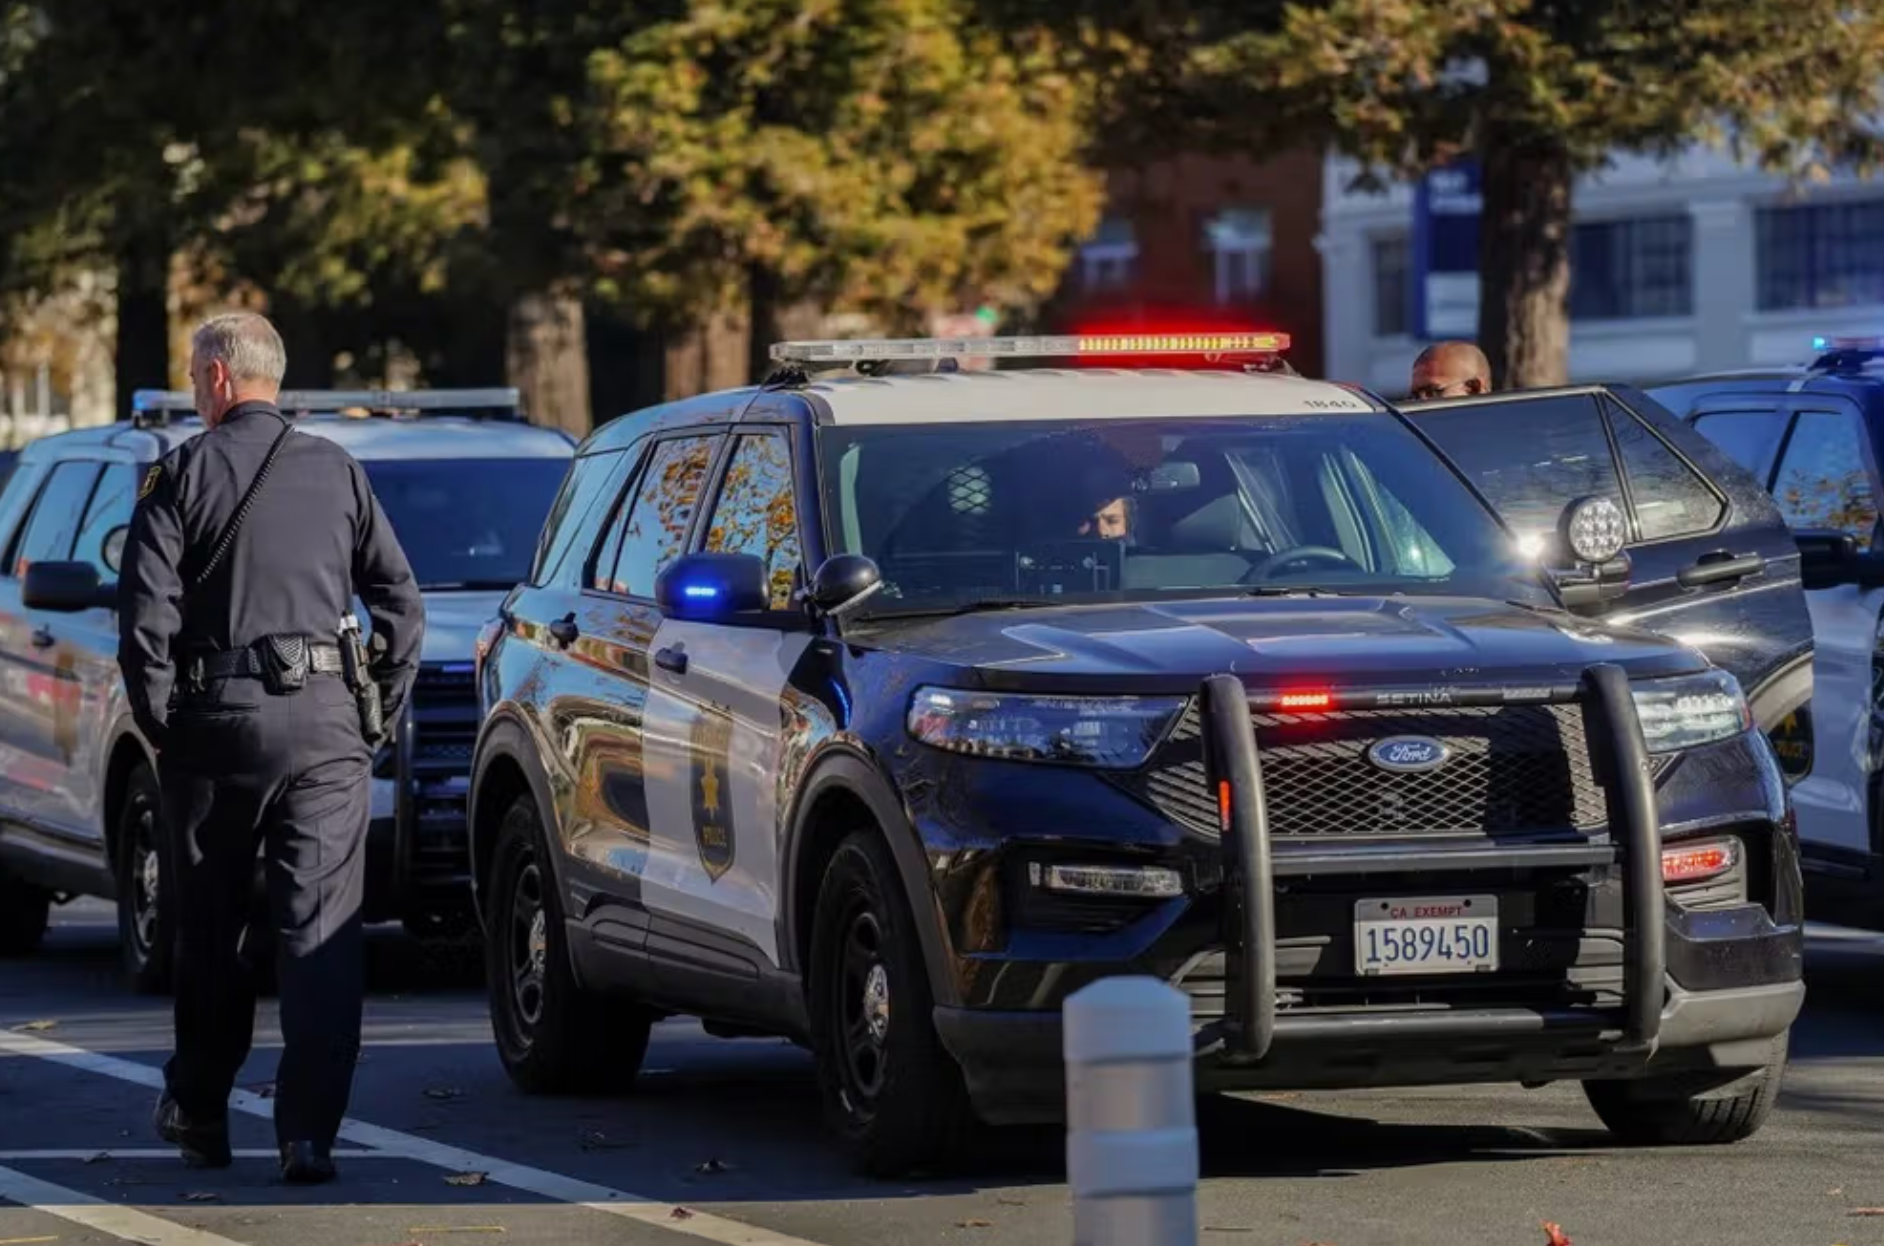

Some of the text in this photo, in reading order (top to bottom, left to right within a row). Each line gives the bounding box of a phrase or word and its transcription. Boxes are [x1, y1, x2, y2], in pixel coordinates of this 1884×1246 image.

[1389, 743, 1432, 761] Ford
[1390, 905, 1463, 919] CA EXEMPT
[1366, 924, 1489, 963] 1589450
